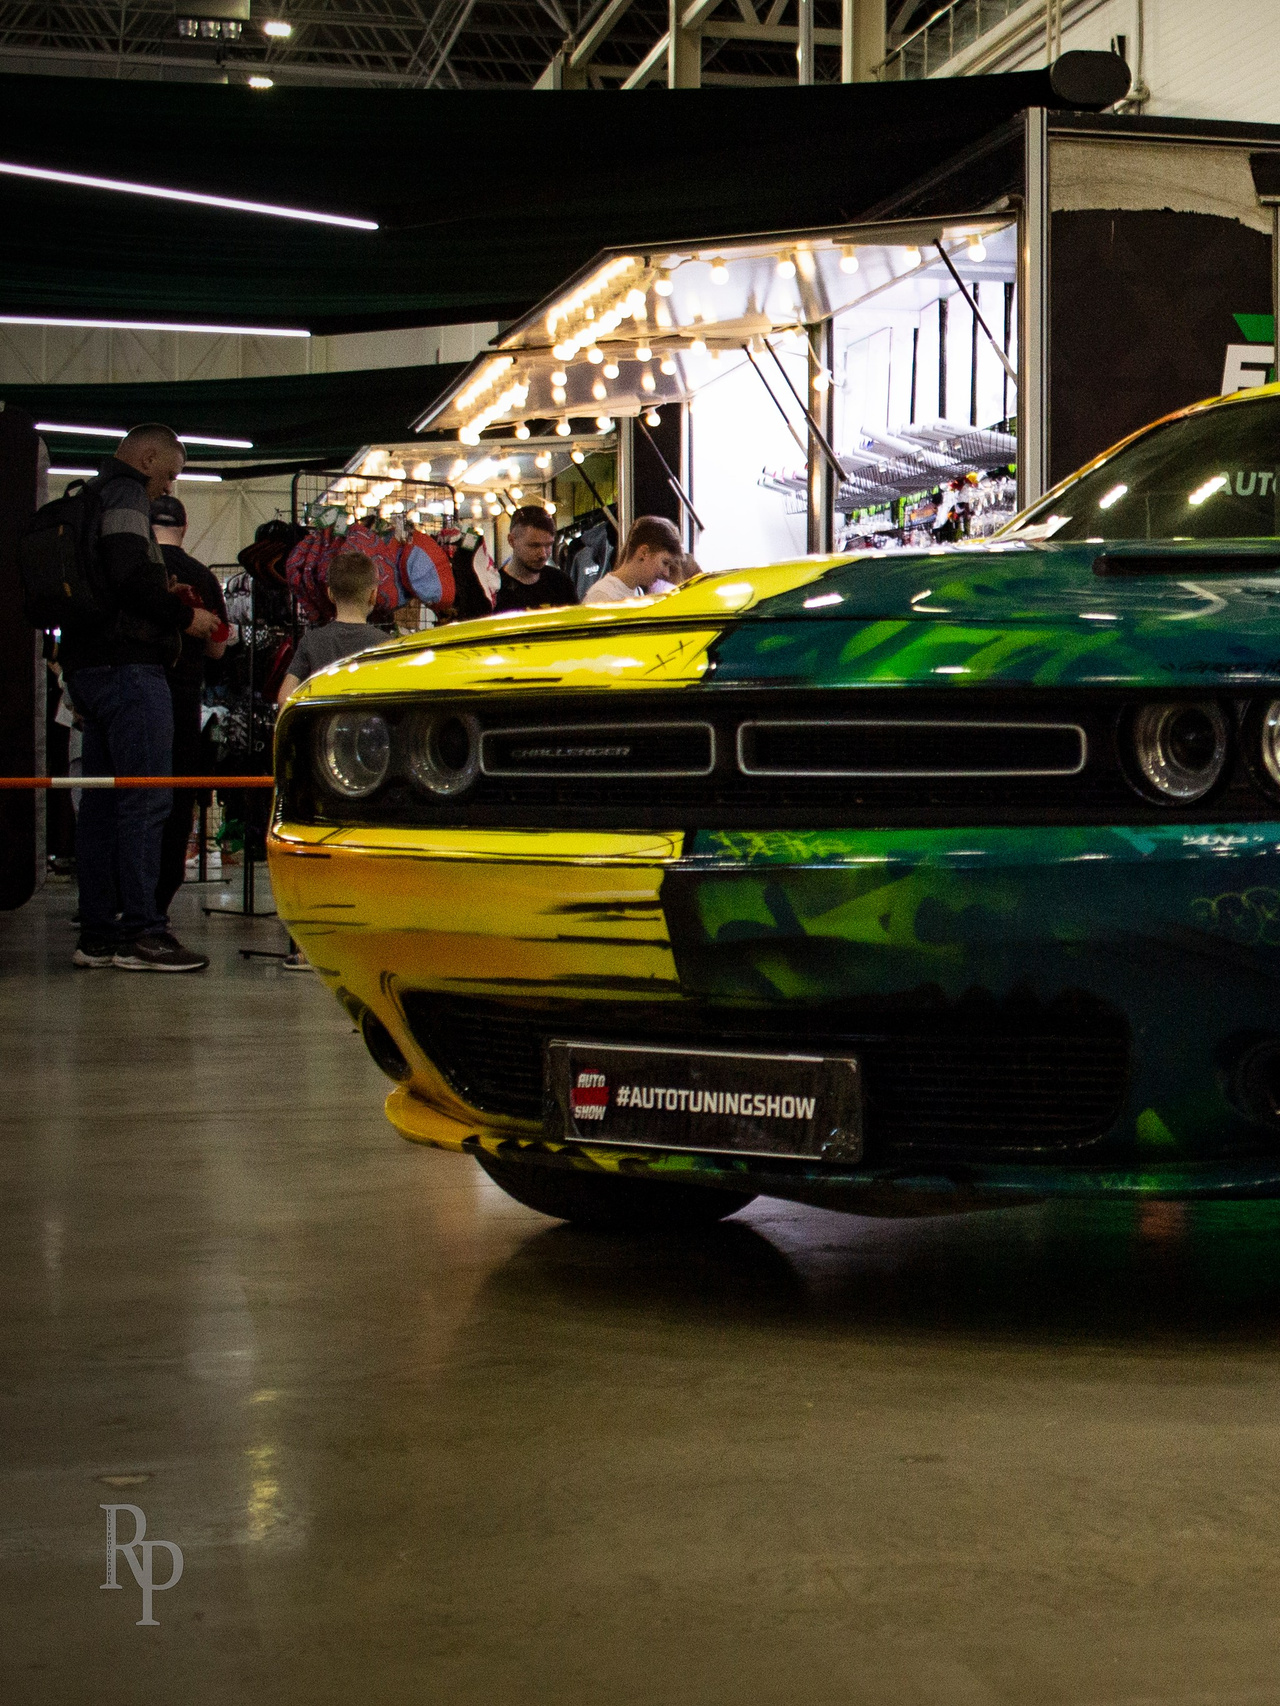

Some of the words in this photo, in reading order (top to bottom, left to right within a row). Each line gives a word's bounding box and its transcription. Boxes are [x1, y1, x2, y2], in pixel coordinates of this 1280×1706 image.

[577, 1073, 606, 1088] AUTO
[616, 1085, 816, 1120] #AUTOTUNINGSHOW
[574, 1105, 606, 1121] SHOW
